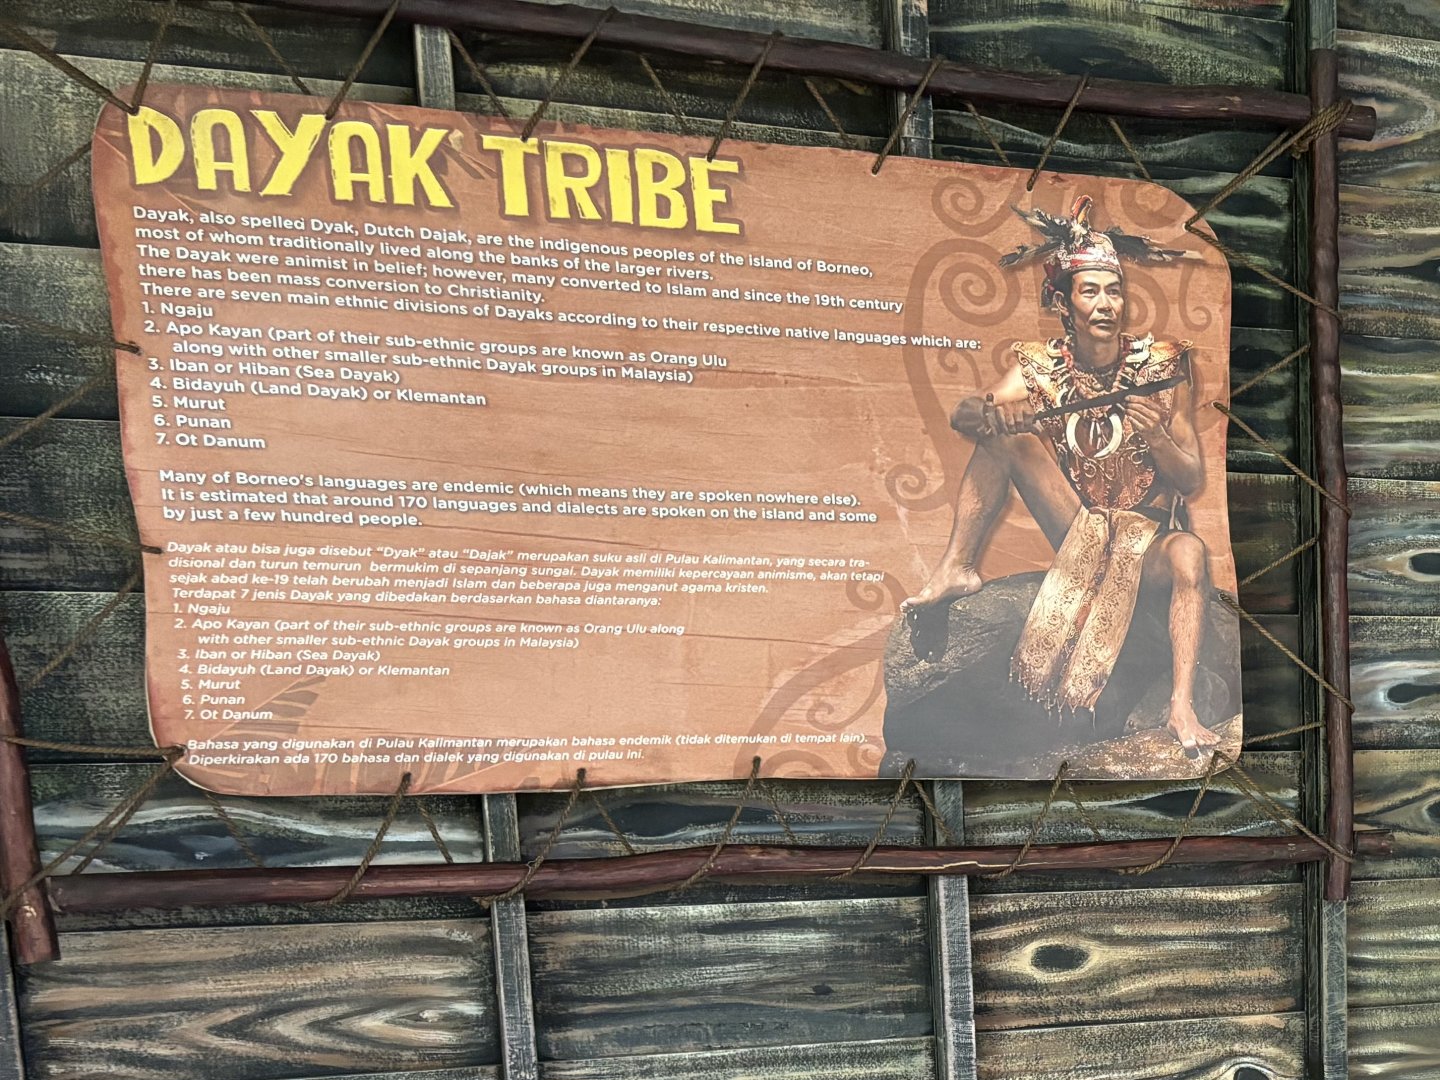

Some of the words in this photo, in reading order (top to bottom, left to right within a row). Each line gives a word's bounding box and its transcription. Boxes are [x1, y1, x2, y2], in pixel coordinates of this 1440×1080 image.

[128, 106, 453, 208] DAYAK
[483, 135, 741, 235] TRIBE
[134, 206, 194, 224] Dayak,
[200, 211, 235, 225] also
[242, 215, 304, 230] spelled
[311, 218, 358, 236] Dyak,
[364, 223, 414, 238] Dutch
[420, 227, 471, 246] Dajak,
[477, 234, 502, 246] are
[508, 234, 534, 249] the
[540, 236, 628, 256] indigenous
[633, 247, 694, 262] peoples
[700, 250, 714, 263] of
[720, 252, 743, 266] the
[749, 254, 792, 270] island
[797, 258, 812, 271] of
[817, 260, 872, 278] Borneo,
[136, 228, 180, 240] most
[186, 229, 203, 241] of
[209, 231, 263, 245] whom
[269, 235, 374, 256] traditionally
[380, 242, 421, 257] lived
[427, 246, 473, 263] along
[479, 250, 505, 264] the
[511, 252, 558, 268] banks
[563, 257, 579, 269] of
[585, 258, 610, 272] the
[616, 260, 661, 277] larger
[667, 265, 713, 280] rivers.
[136, 244, 169, 258] The
[176, 246, 231, 263] Dayak
[236, 253, 278, 265] were
[285, 255, 347, 270] animist
[353, 257, 368, 271] in
[374, 260, 427, 278] belief;
[433, 264, 506, 283] however,
[512, 273, 555, 288] many
[561, 277, 640, 292] converted
[646, 281, 661, 294] to
[667, 282, 706, 296] Islam
[712, 288, 739, 300] and
[744, 289, 781, 303] since
[786, 292, 810, 305] the
[815, 294, 844, 307] 19th
[849, 298, 902, 314] century
[139, 263, 185, 278] there
[192, 266, 222, 280] has
[228, 268, 271, 283] been
[277, 274, 320, 287] mass
[326, 277, 419, 293] conversion
[425, 283, 442, 295] to
[447, 284, 544, 305] Christianity.
[140, 282, 191, 297] There
[198, 288, 225, 299] are
[232, 290, 281, 302] seven
[288, 292, 329, 305] main
[335, 294, 388, 309] ethnic
[394, 298, 467, 315] divisions
[473, 303, 489, 316] of
[495, 305, 553, 322] Dayaks
[558, 312, 636, 329] according
[642, 316, 657, 328] to
[663, 317, 698, 330] their
[704, 322, 780, 336] respective
[786, 326, 829, 339] native
[834, 329, 906, 346] languages
[911, 335, 951, 348] which
[956, 339, 980, 349] are:
[142, 301, 154, 314] 1.
[161, 302, 212, 319] Ngaju
[153, 395, 167, 408] 5.
[174, 395, 225, 410] Murut
[154, 413, 170, 426] 6.
[176, 414, 231, 429] Punan
[156, 432, 169, 444] 7.
[176, 433, 197, 446] Ot
[203, 433, 265, 449] Danum
[160, 469, 206, 485] Many
[212, 471, 229, 484] of
[236, 471, 313, 486] Borneo's
[319, 474, 406, 492] languages
[412, 481, 437, 492] are
[443, 481, 513, 494] endemic
[519, 483, 572, 496] (which
[578, 488, 627, 498] means
[632, 487, 665, 501] they
[671, 491, 693, 500] are
[699, 490, 751, 502] spoken
[757, 492, 818, 504] nowhere
[823, 493, 860, 507] else).
[173, 588, 236, 600] Terdapat
[241, 589, 249, 599] 7
[251, 589, 285, 602] jenis
[290, 589, 333, 602] Dayak
[337, 592, 371, 604] yang
[375, 591, 446, 603] dibedakan
[451, 592, 532, 604] berdasarkan
[536, 594, 581, 605] bahasa
[585, 595, 661, 607] diantaranya:
[174, 603, 182, 613] 1.
[188, 603, 230, 616] Ngaju
[178, 648, 189, 659] 3.
[195, 648, 226, 660] Iban
[231, 651, 246, 660] or
[251, 649, 292, 660] Hiban
[297, 649, 328, 661] (Sea
[333, 650, 380, 663] Dayak)
